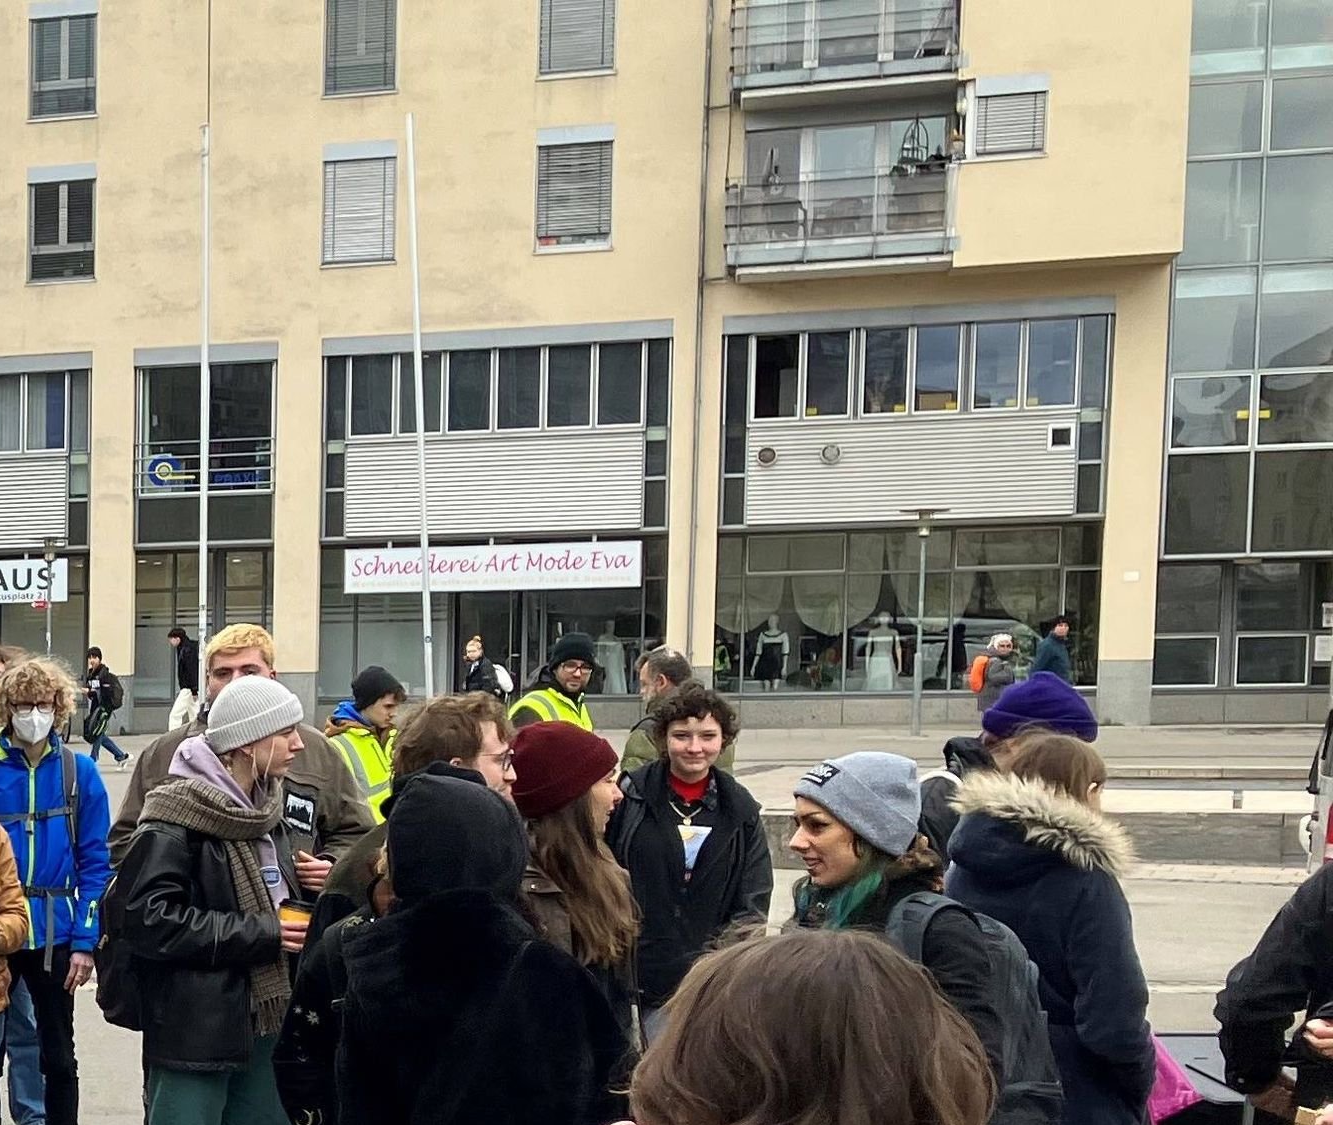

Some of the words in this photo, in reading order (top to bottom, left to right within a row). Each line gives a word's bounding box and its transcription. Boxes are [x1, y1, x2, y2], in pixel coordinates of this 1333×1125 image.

[352, 553, 482, 577] Schneiderei
[485, 552, 521, 573] Art
[526, 549, 587, 572] Mode
[591, 550, 633, 570] Eva
